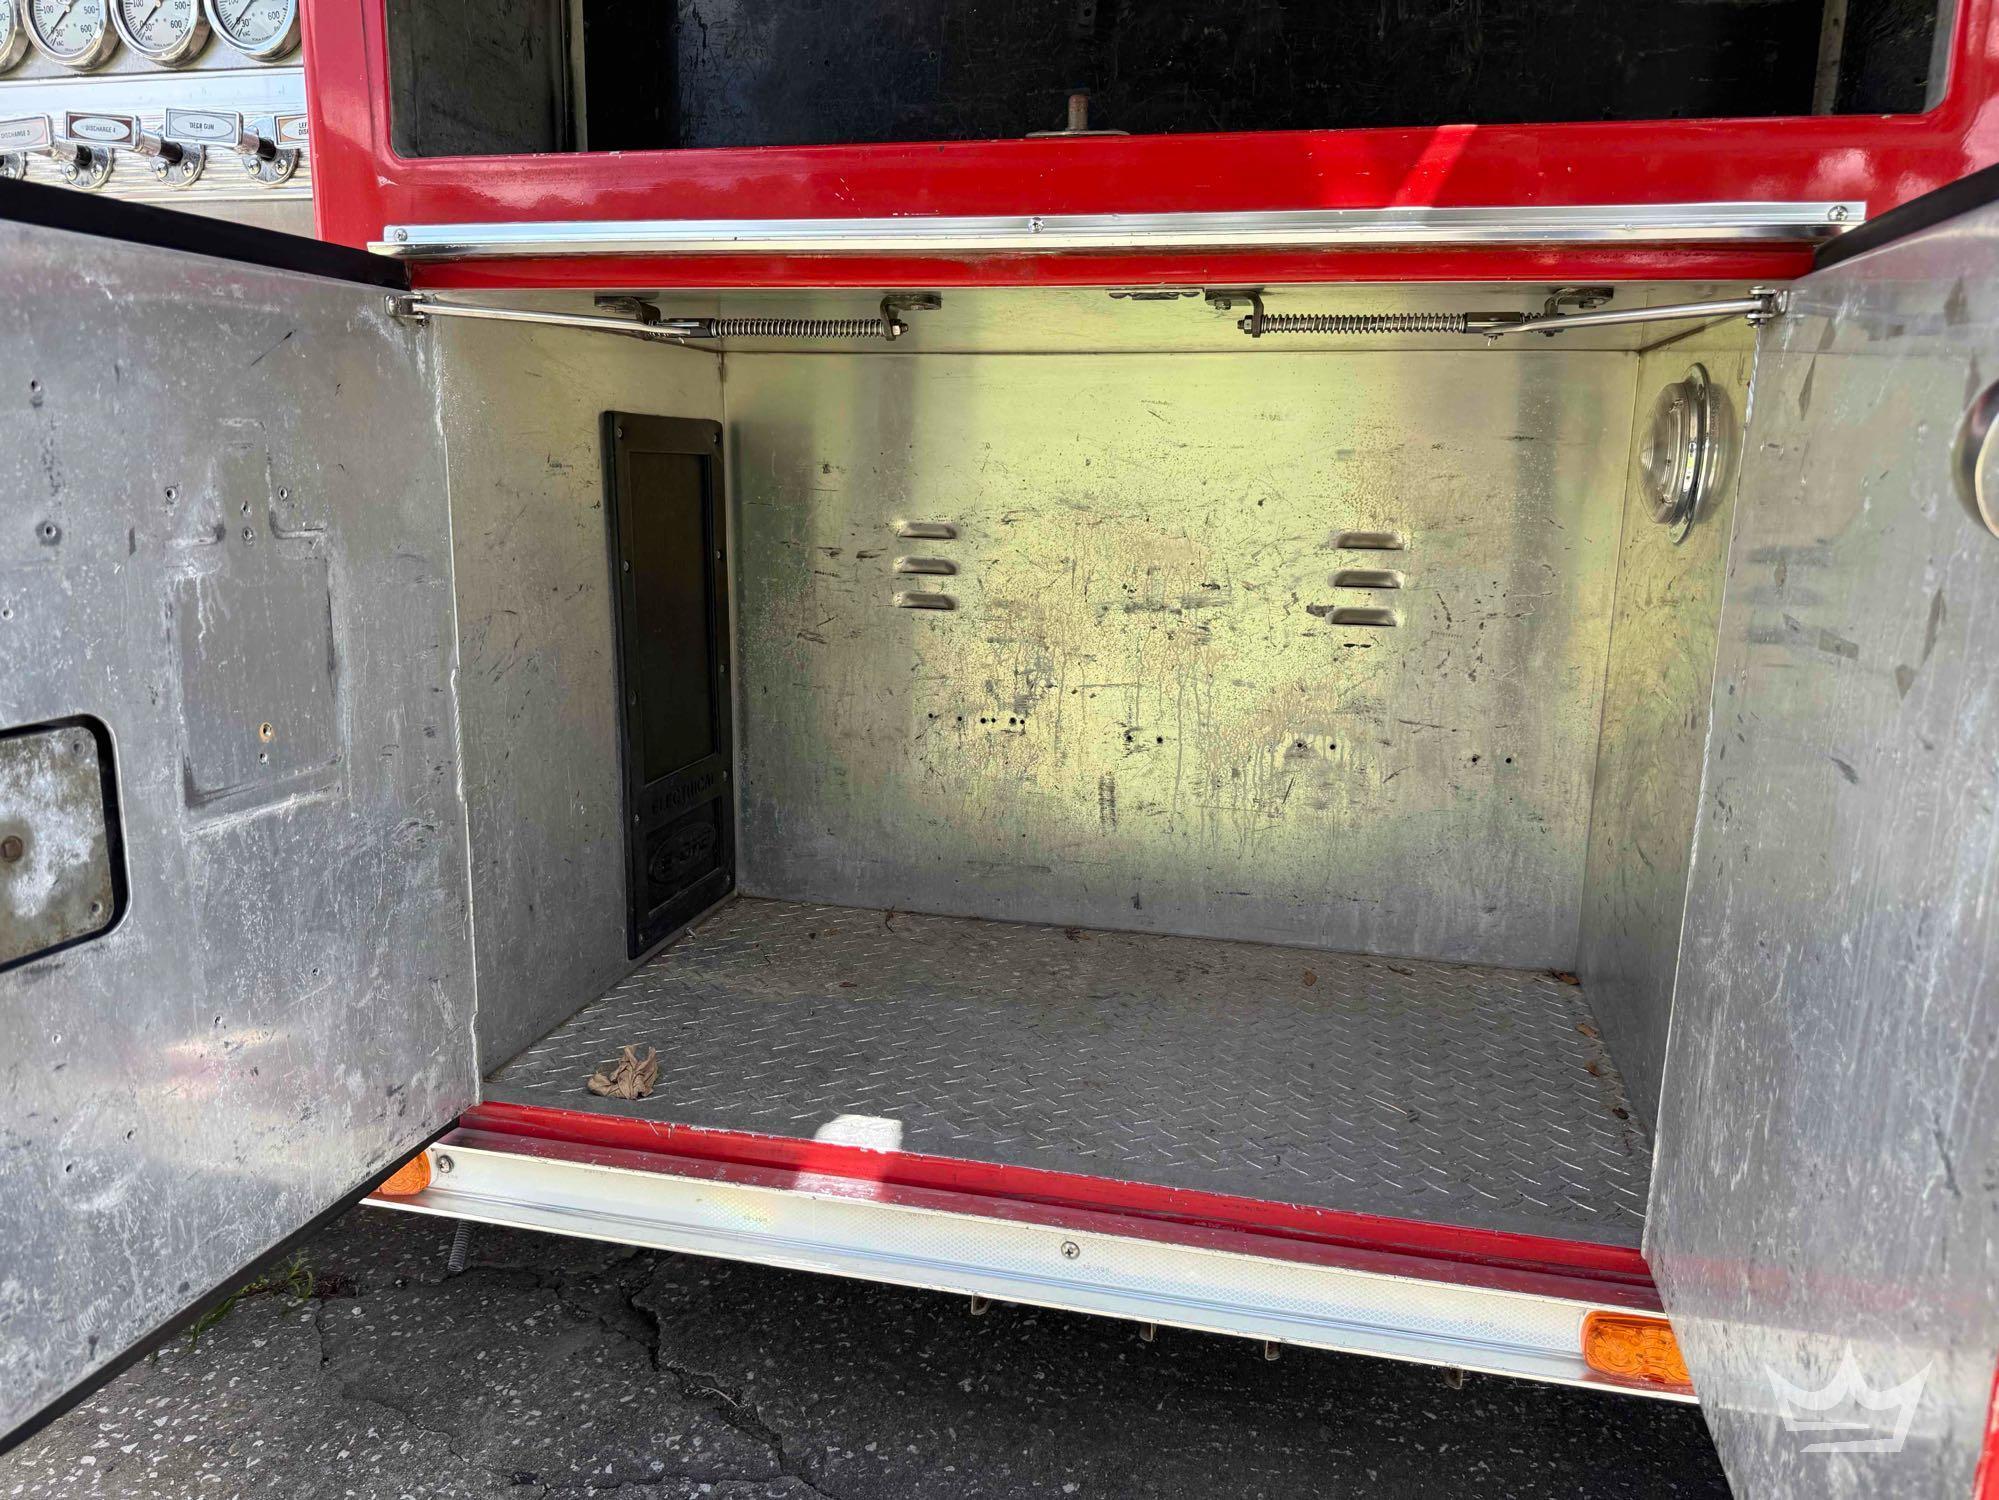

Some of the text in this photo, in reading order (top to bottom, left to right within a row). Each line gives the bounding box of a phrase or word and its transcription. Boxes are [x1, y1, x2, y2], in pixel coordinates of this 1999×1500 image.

[43, 5, 54, 15] 100
[83, 5, 96, 14] 500
[174, 2, 187, 10] 500
[267, 10, 280, 21] 600
[80, 24, 92, 34] 600
[170, 20, 182, 29] 600
[85, 125, 111, 133] DISCHARGE
